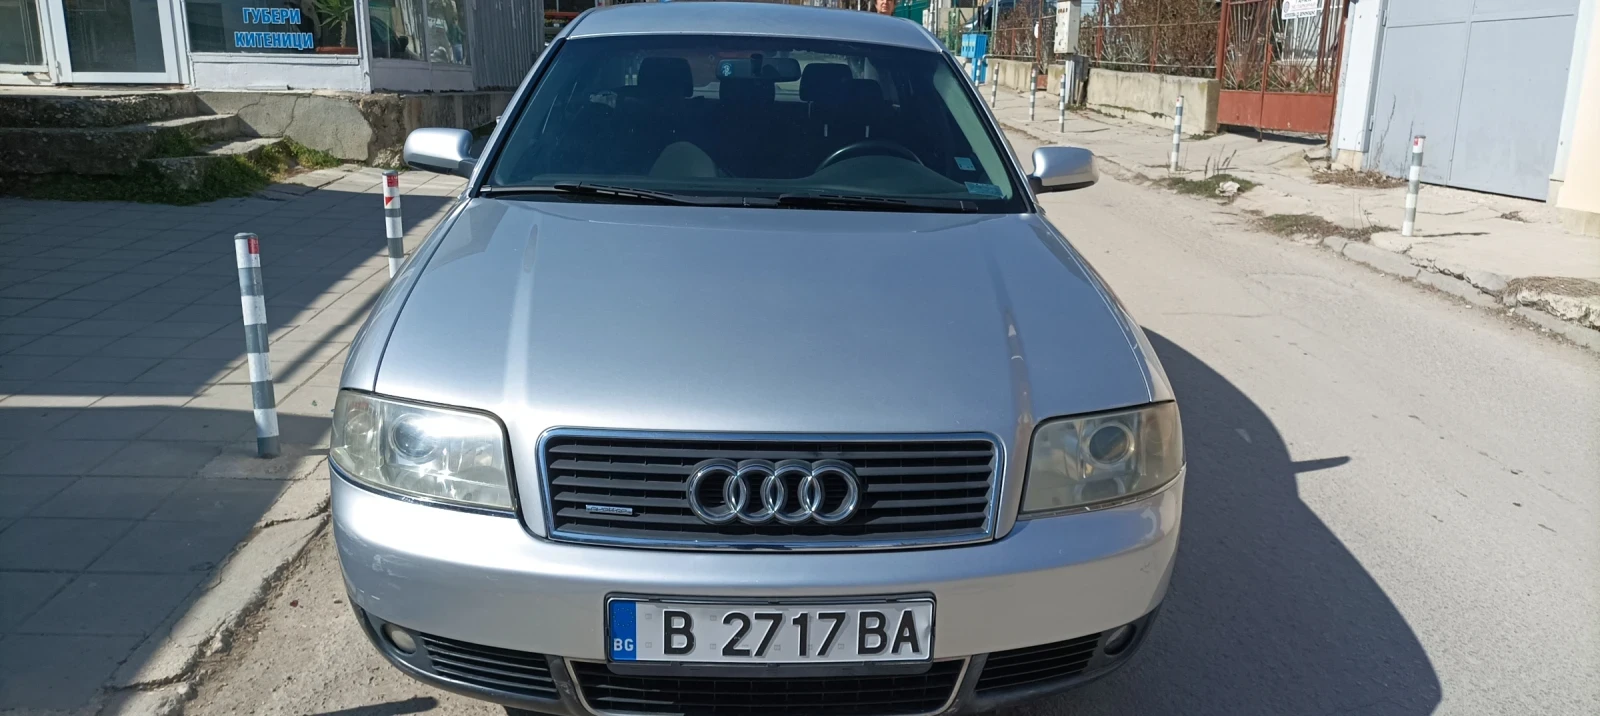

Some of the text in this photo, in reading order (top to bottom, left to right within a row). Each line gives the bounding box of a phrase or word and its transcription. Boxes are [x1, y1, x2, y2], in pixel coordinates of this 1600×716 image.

[242, 7, 302, 24] ГУБЕРИ
[234, 31, 314, 50] КИТЕНИЦИ
[663, 610, 920, 657] B 2717 BA
[613, 638, 634, 652] BG
